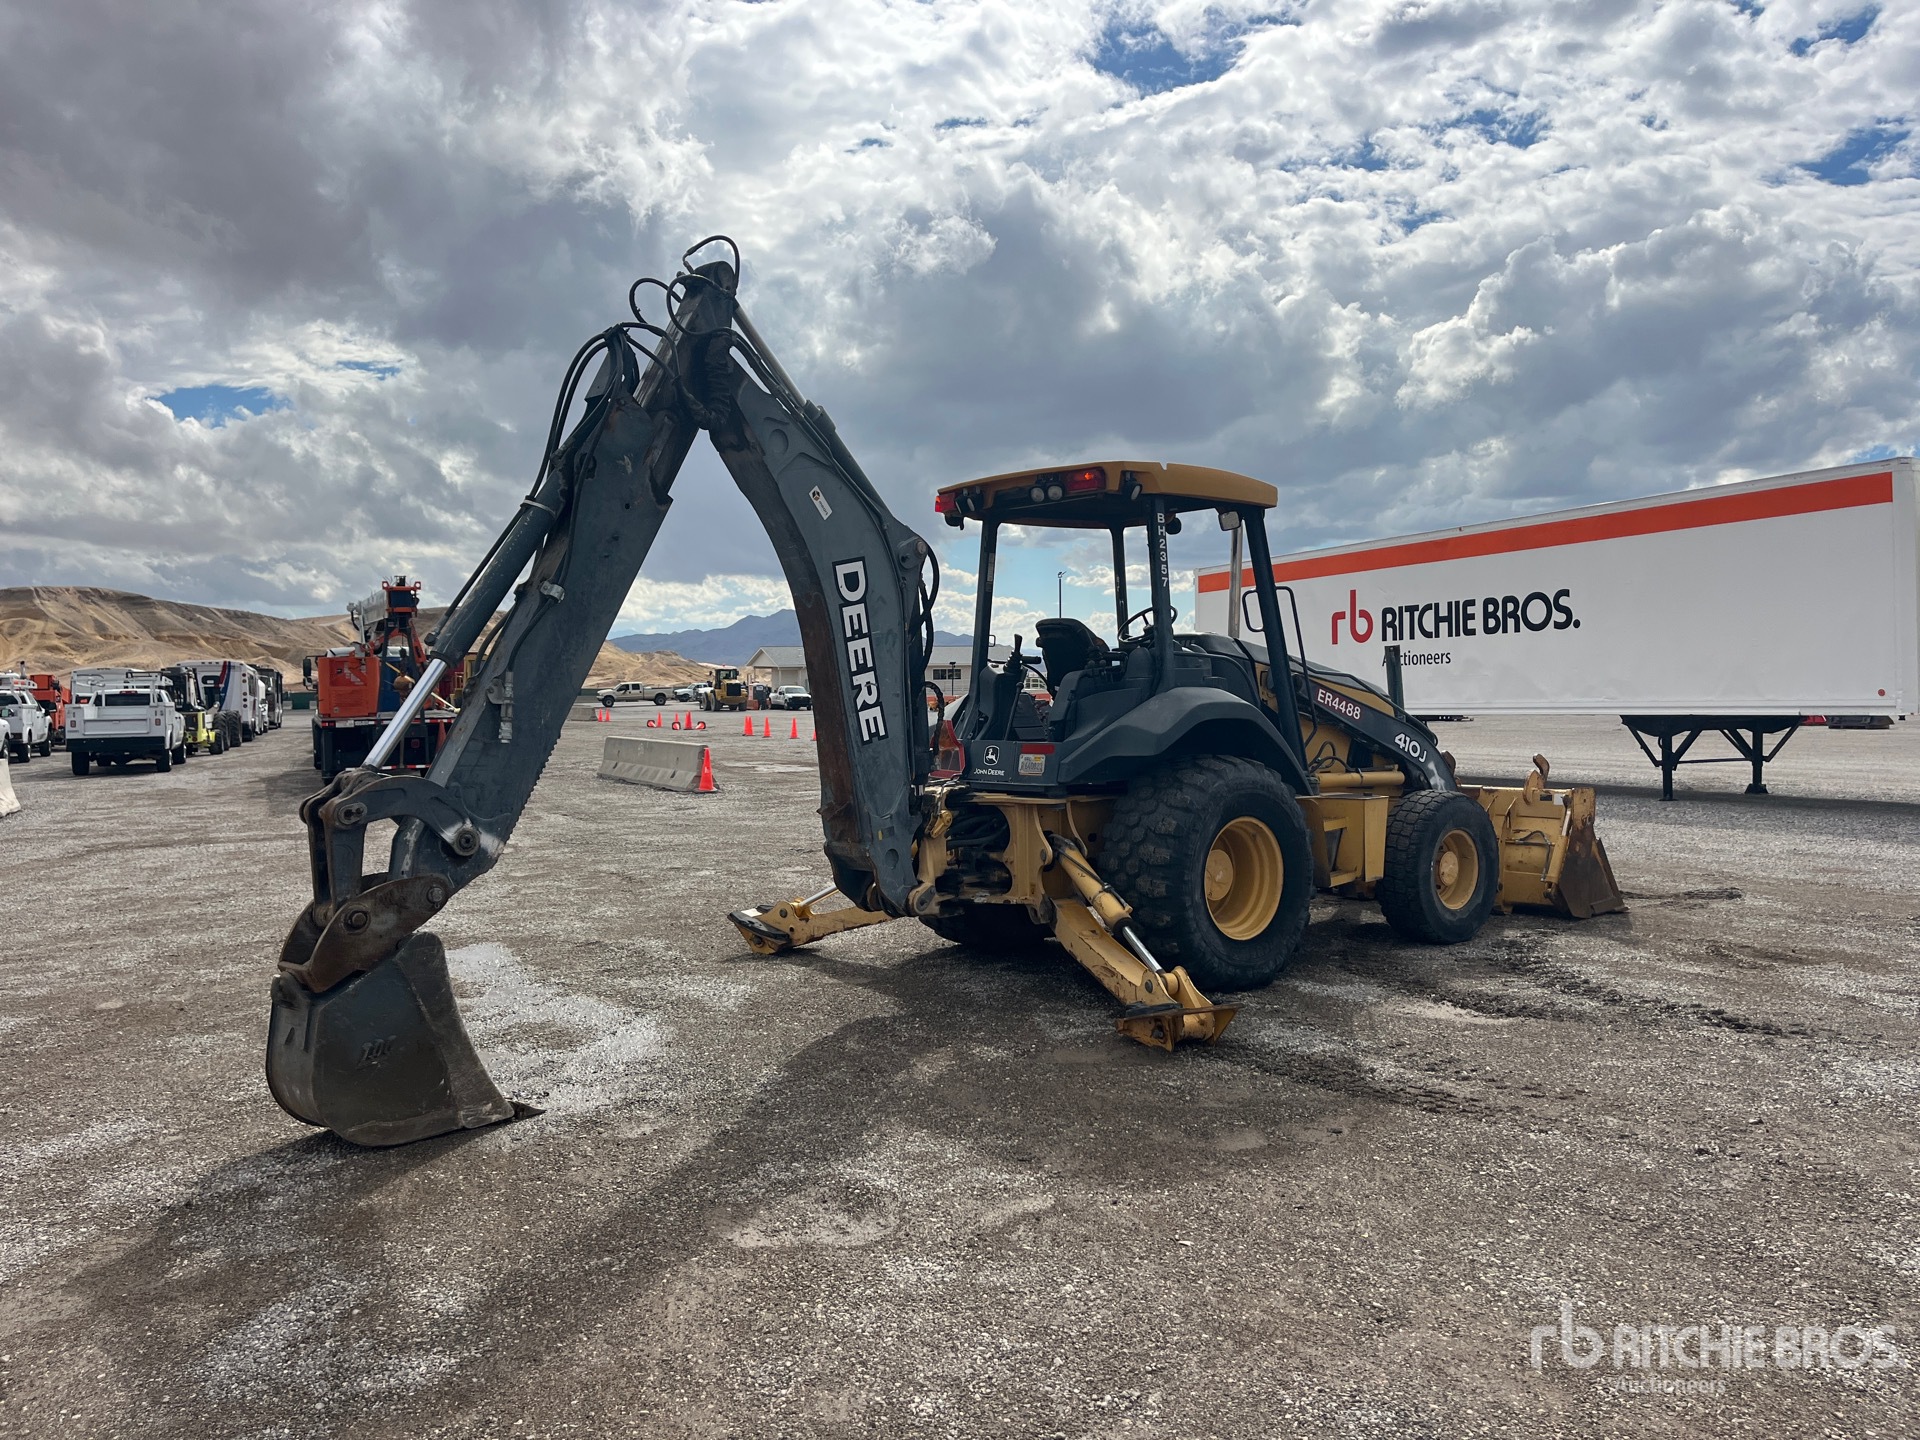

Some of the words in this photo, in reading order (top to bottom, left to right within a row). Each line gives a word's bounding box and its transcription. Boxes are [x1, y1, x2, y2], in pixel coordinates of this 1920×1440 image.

[1381, 599, 1477, 642] RITCHIE
[1482, 589, 1581, 635] BROS.
[835, 561, 887, 742] DEERE
[1382, 650, 1451, 667] ctioneers
[1317, 688, 1361, 720] ER4488
[1394, 733, 1427, 763] 410J
[987, 768, 1005, 776] DEERE
